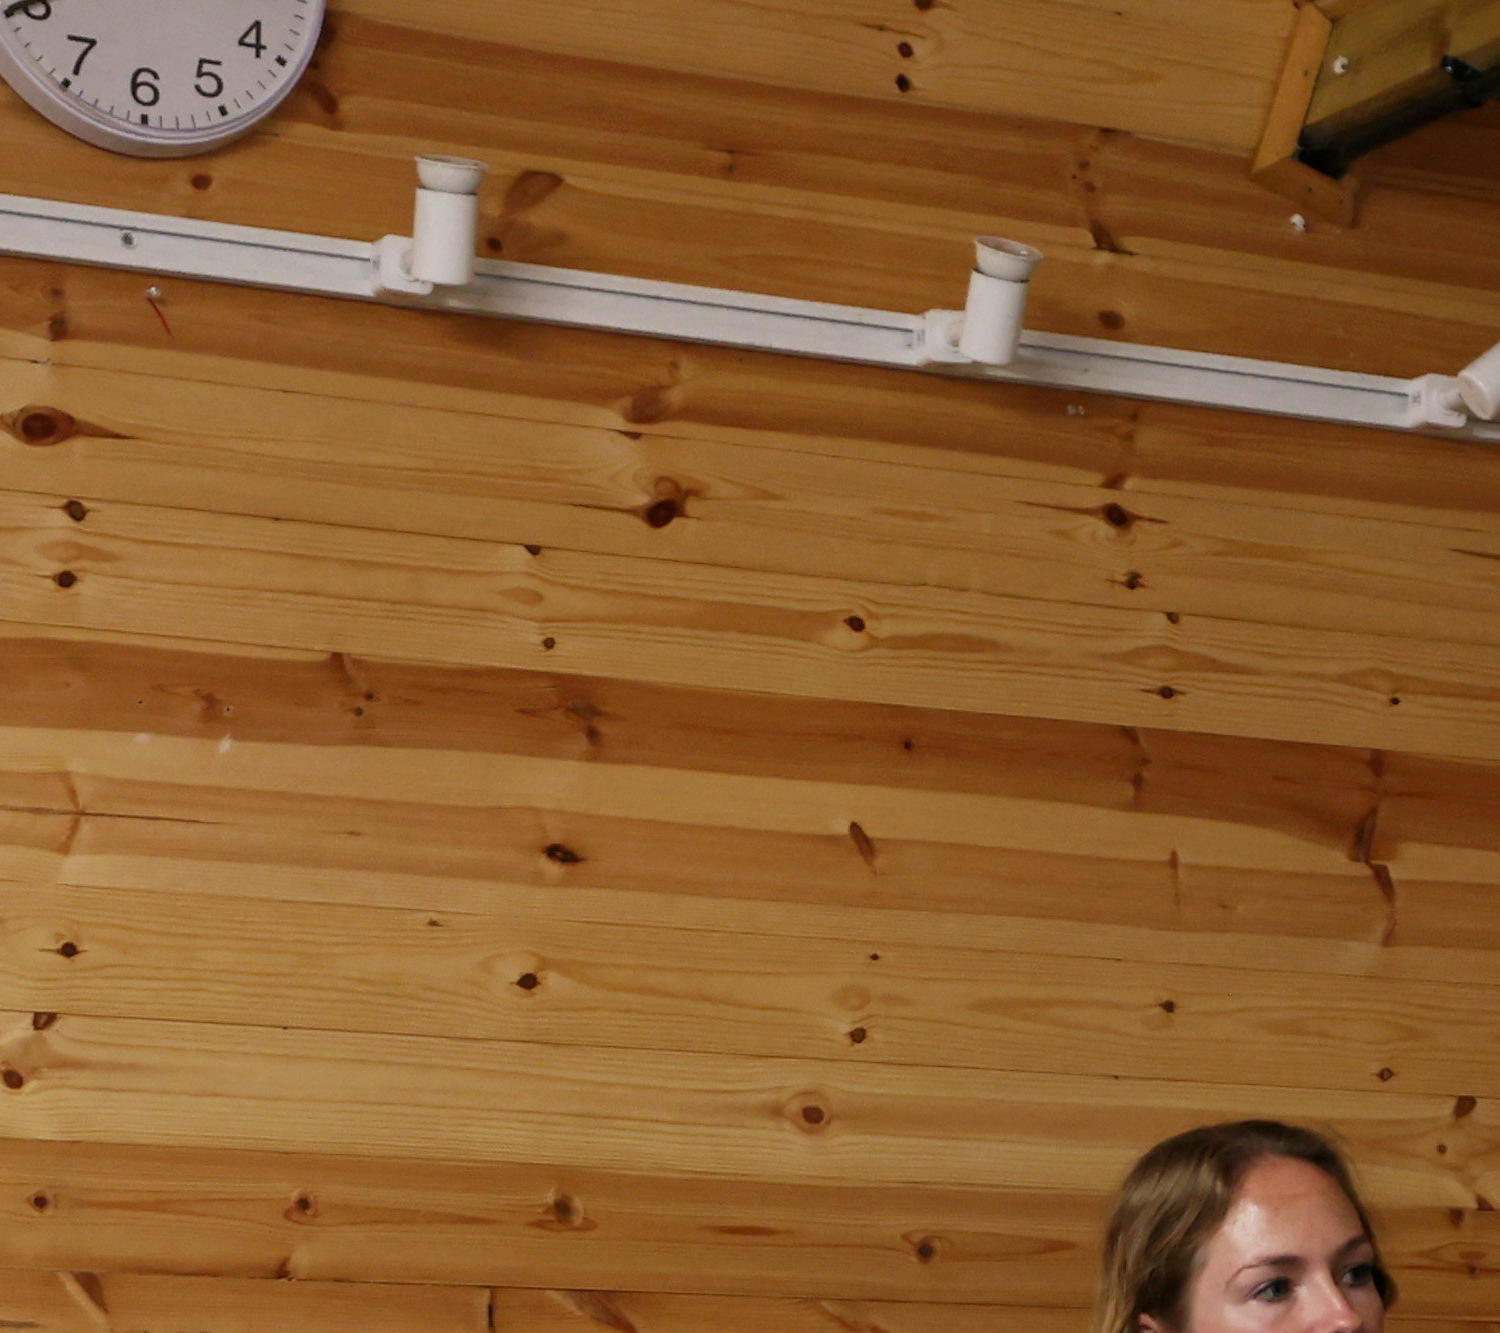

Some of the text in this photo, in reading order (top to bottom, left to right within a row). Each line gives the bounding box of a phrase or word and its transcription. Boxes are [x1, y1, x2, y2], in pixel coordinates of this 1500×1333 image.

[67, 34, 97, 76] 7
[238, 19, 267, 59] 4
[130, 67, 160, 107] 6
[194, 58, 224, 98] 5
